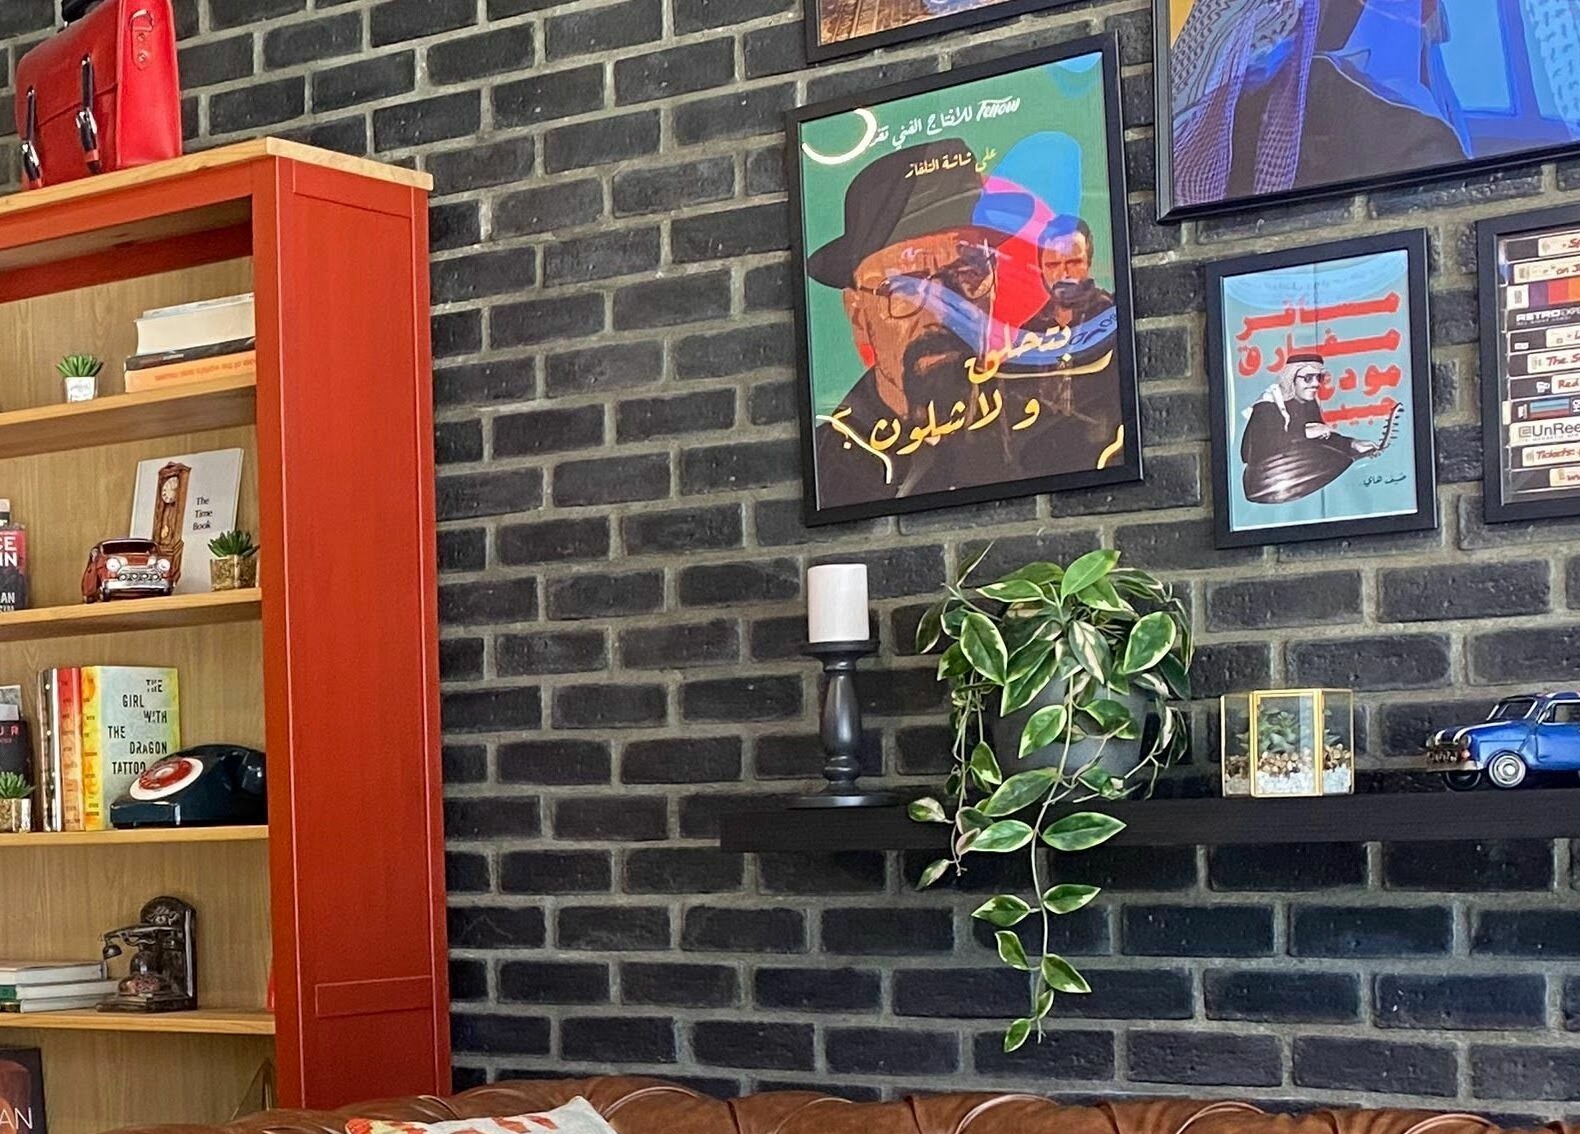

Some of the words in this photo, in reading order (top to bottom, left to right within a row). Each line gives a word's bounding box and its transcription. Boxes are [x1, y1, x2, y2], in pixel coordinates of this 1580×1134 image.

[196, 497, 210, 506] The
[195, 509, 213, 518] Time
[192, 522, 211, 531] Book
[122, 694, 144, 708] GIRL
[143, 710, 167, 724] WITH
[108, 726, 126, 739] THE
[129, 740, 167, 755] DRAGON
